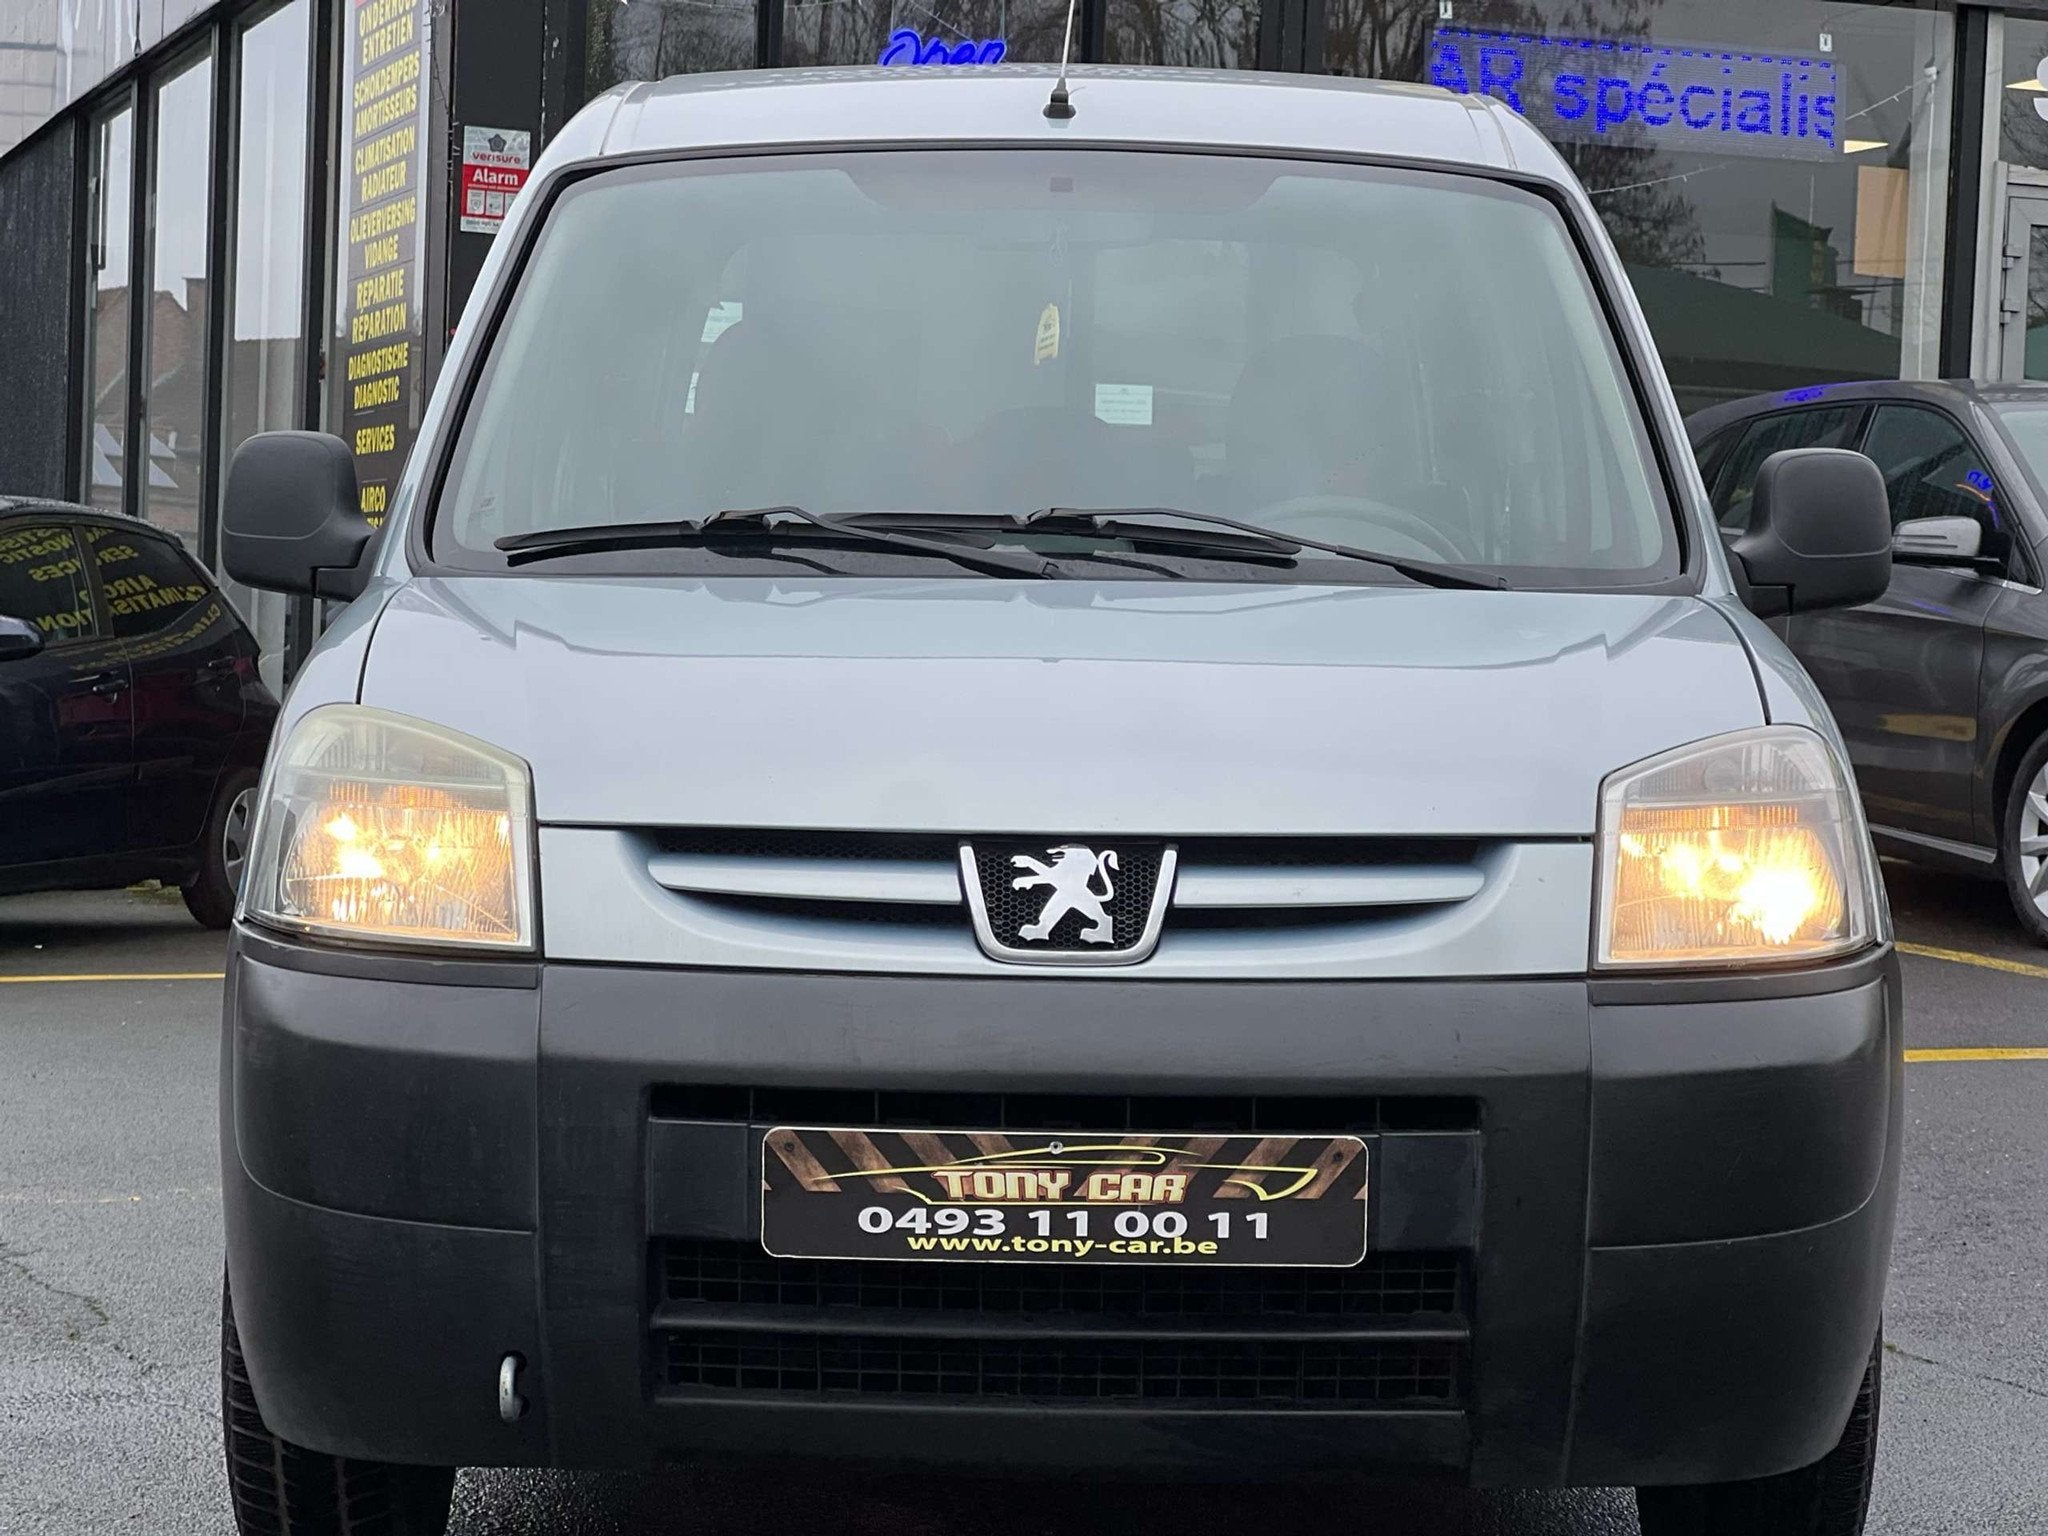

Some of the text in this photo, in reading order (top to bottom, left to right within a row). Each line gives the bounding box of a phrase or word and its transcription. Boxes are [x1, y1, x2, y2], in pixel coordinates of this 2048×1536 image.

[359, 0, 417, 37] ONDERHO
[363, 12, 413, 66] ENTRETIEN
[354, 50, 420, 109] SCHOKDEMPERS
[355, 83, 417, 139] AMORTISSEURS
[356, 125, 415, 175] CLIMATISATION
[472, 151, 521, 164] verisure
[362, 160, 407, 204] RADIATEUR
[473, 168, 519, 186] Alarm
[351, 196, 416, 245] OLIEVERVERSING
[365, 234, 399, 270] VIDANGE
[356, 268, 405, 310] REPARATIE
[352, 302, 407, 344] RÉPARATION
[348, 341, 409, 381] DIAGNOSTISCHE
[354, 375, 400, 410] DIAGNOSTIC
[356, 424, 395, 455] SERVICES
[361, 485, 386, 513] AIRCO
[931, 1169, 1188, 1203] TONY CAR
[858, 1206, 1268, 1239] 0493 11 00 11
[906, 1235, 1219, 1258] www.tony-car.be
